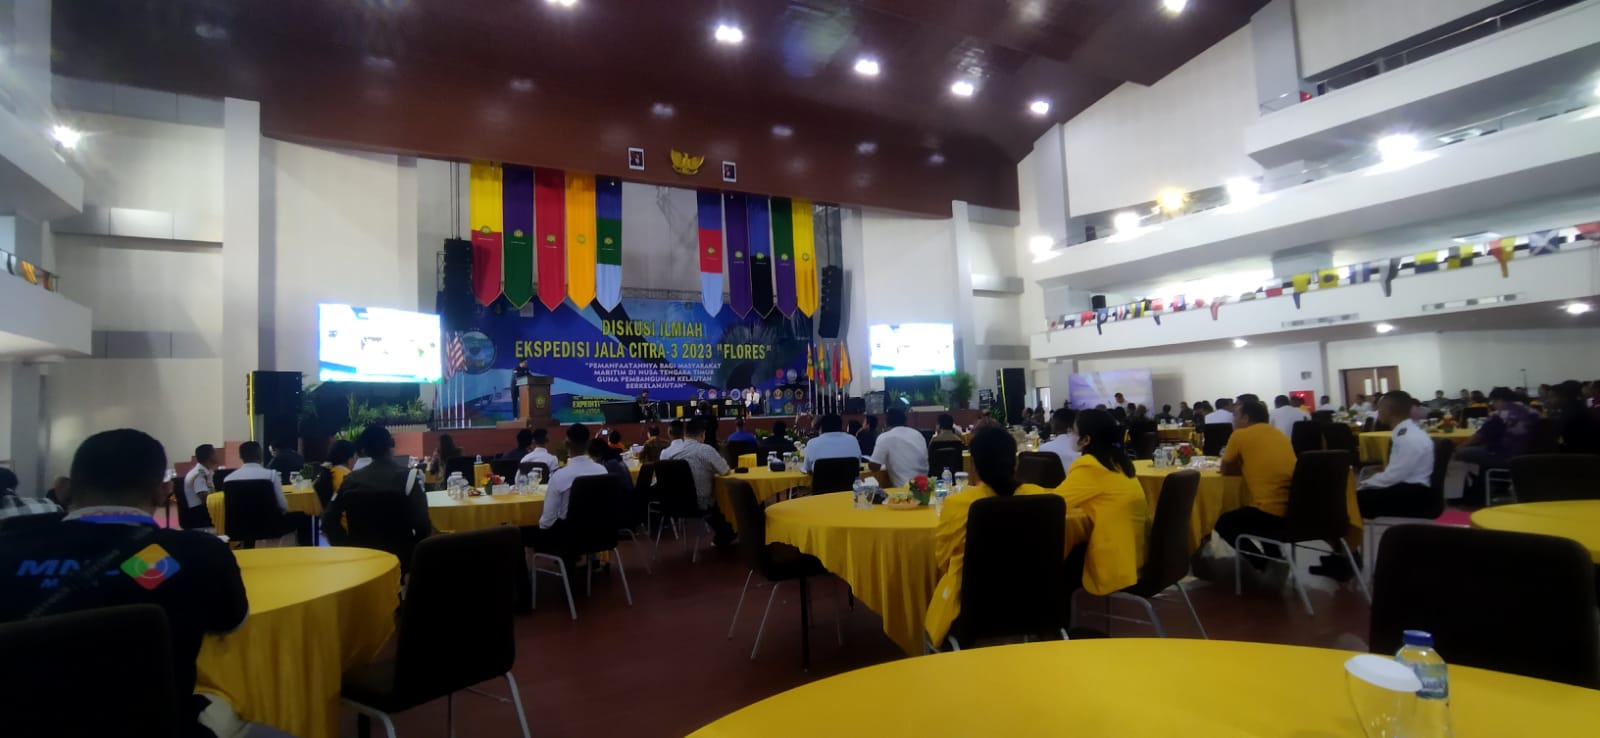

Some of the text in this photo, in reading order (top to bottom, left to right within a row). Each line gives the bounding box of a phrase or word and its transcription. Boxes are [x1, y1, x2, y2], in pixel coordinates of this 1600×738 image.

[602, 319, 703, 338] DISKUSI ILMIAH
[515, 340, 772, 361] EKSPEDISI JALA CITRA-3 2023 "FLORES"
